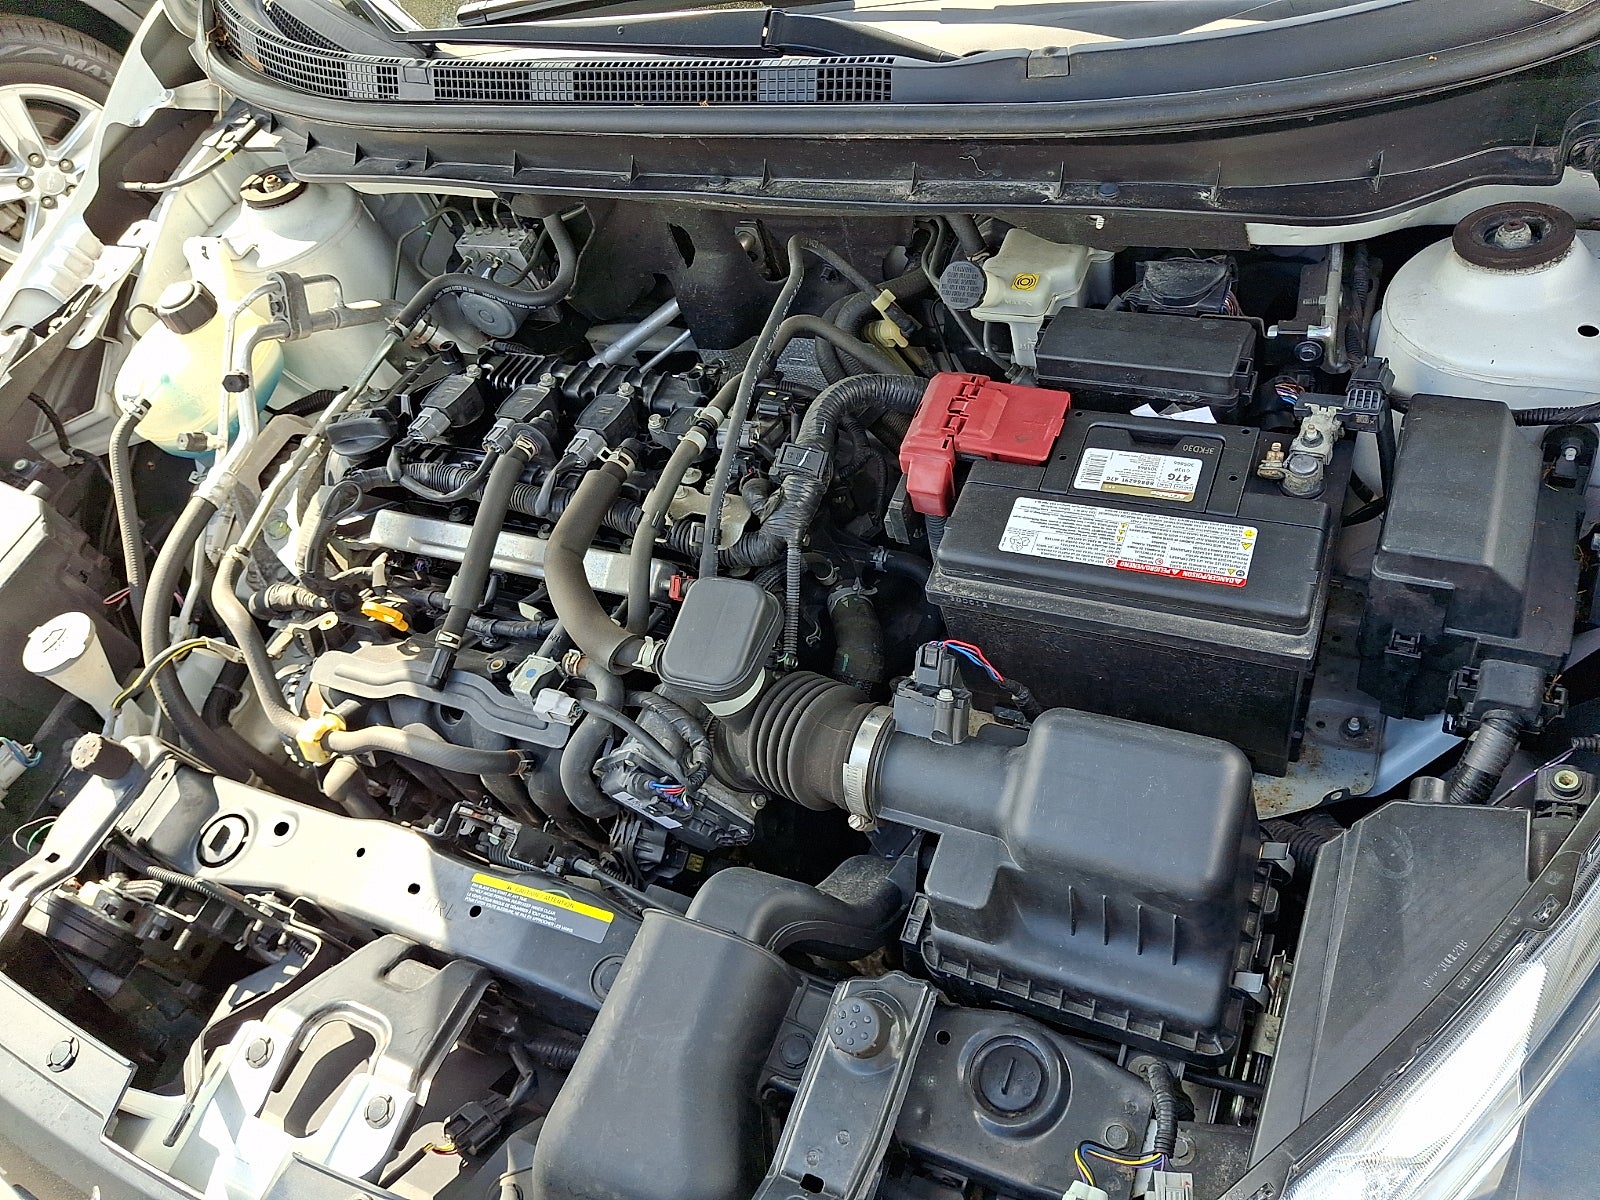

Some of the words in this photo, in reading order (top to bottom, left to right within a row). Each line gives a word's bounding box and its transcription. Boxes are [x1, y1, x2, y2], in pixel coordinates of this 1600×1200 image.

[1182, 444, 1214, 455] 3FKD30
[1166, 471, 1191, 483] 47G
[1181, 570, 1234, 584] DANGER/POISON
